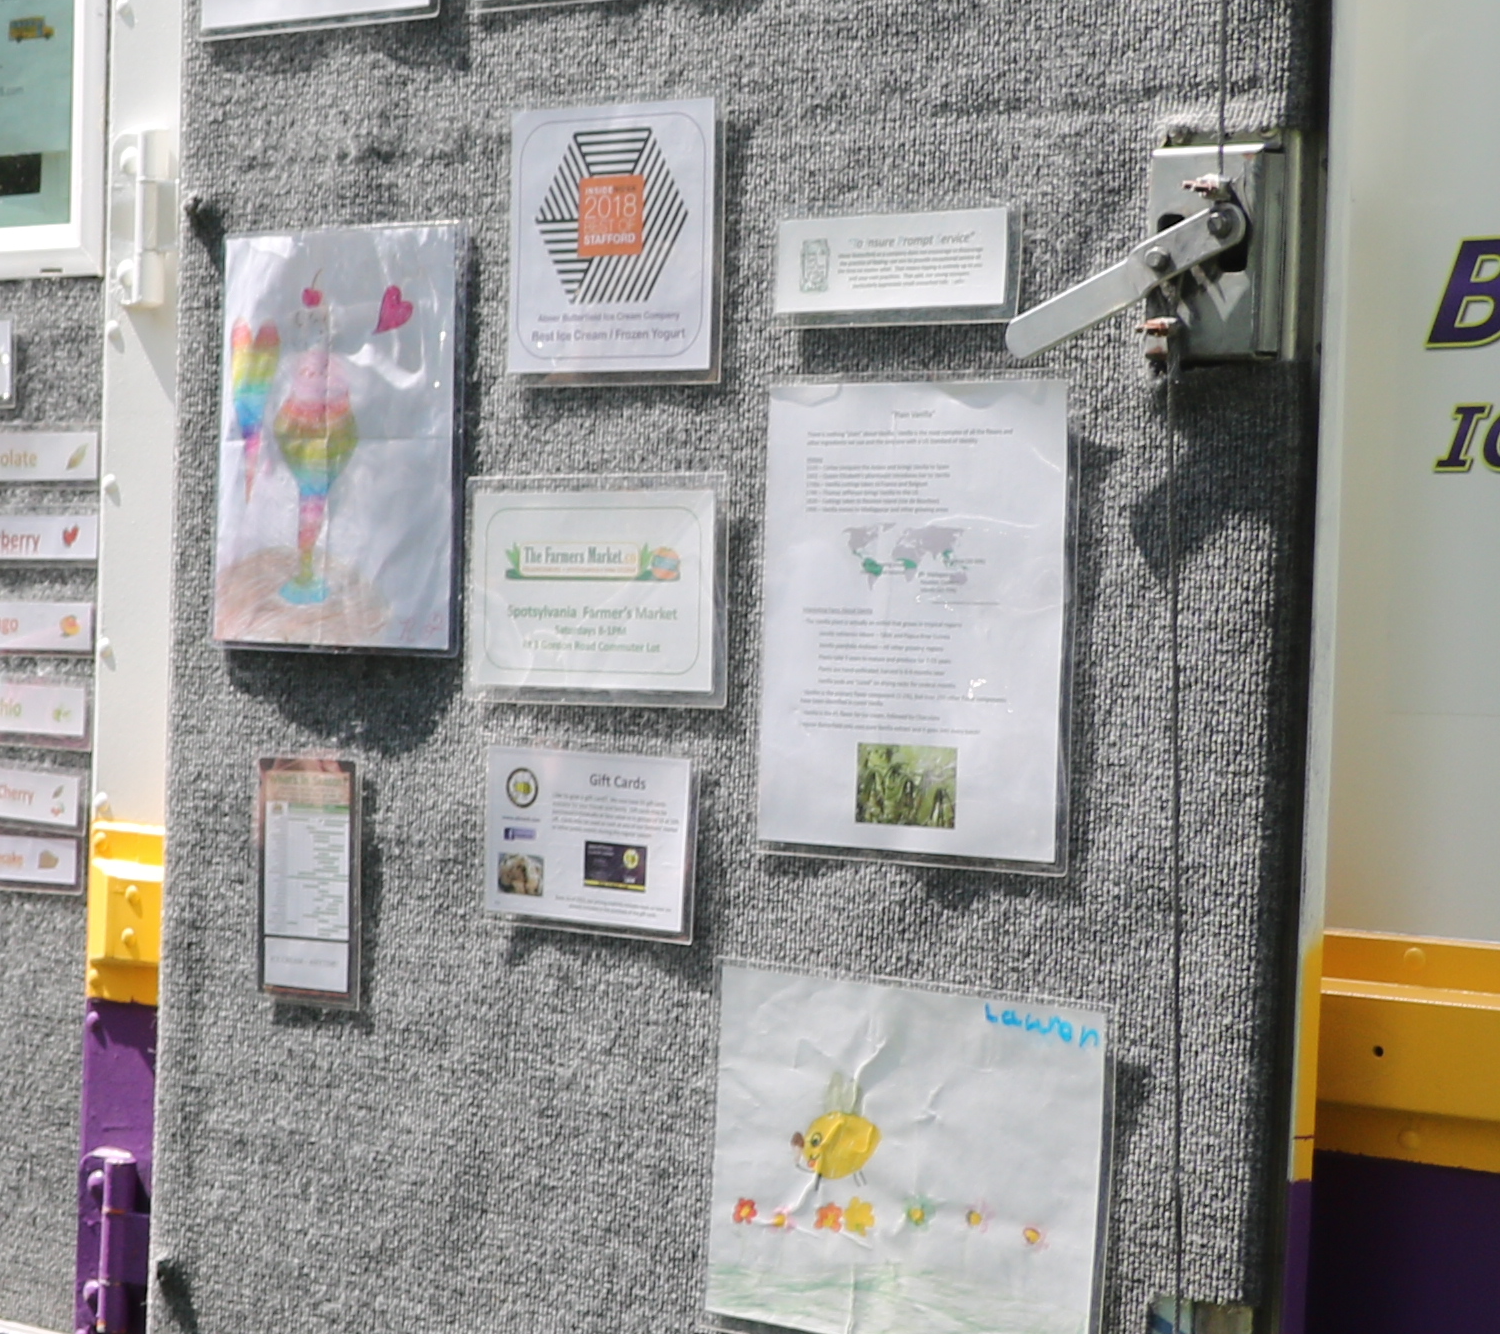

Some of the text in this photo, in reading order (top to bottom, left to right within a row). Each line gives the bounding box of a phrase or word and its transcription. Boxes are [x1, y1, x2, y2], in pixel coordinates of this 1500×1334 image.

[585, 193, 637, 219] 2018
[584, 217, 635, 234] BEST OF
[584, 232, 636, 245] STAFFORD
[532, 330, 554, 342] Best
[557, 330, 571, 341] Ice
[574, 329, 607, 341] Cream
[615, 328, 649, 340] Frozen
[652, 328, 686, 342] Yogurt
[524, 547, 542, 564] The
[545, 546, 585, 564] Farmers
[507, 605, 678, 621] Spotsylvania Farmer's Market
[555, 625, 596, 637] Saturdays
[541, 641, 572, 651] Gordon
[574, 641, 596, 651] Road
[599, 641, 644, 652] Commuter
[646, 642, 660, 653] Lot
[590, 773, 646, 790] Gift Cards
